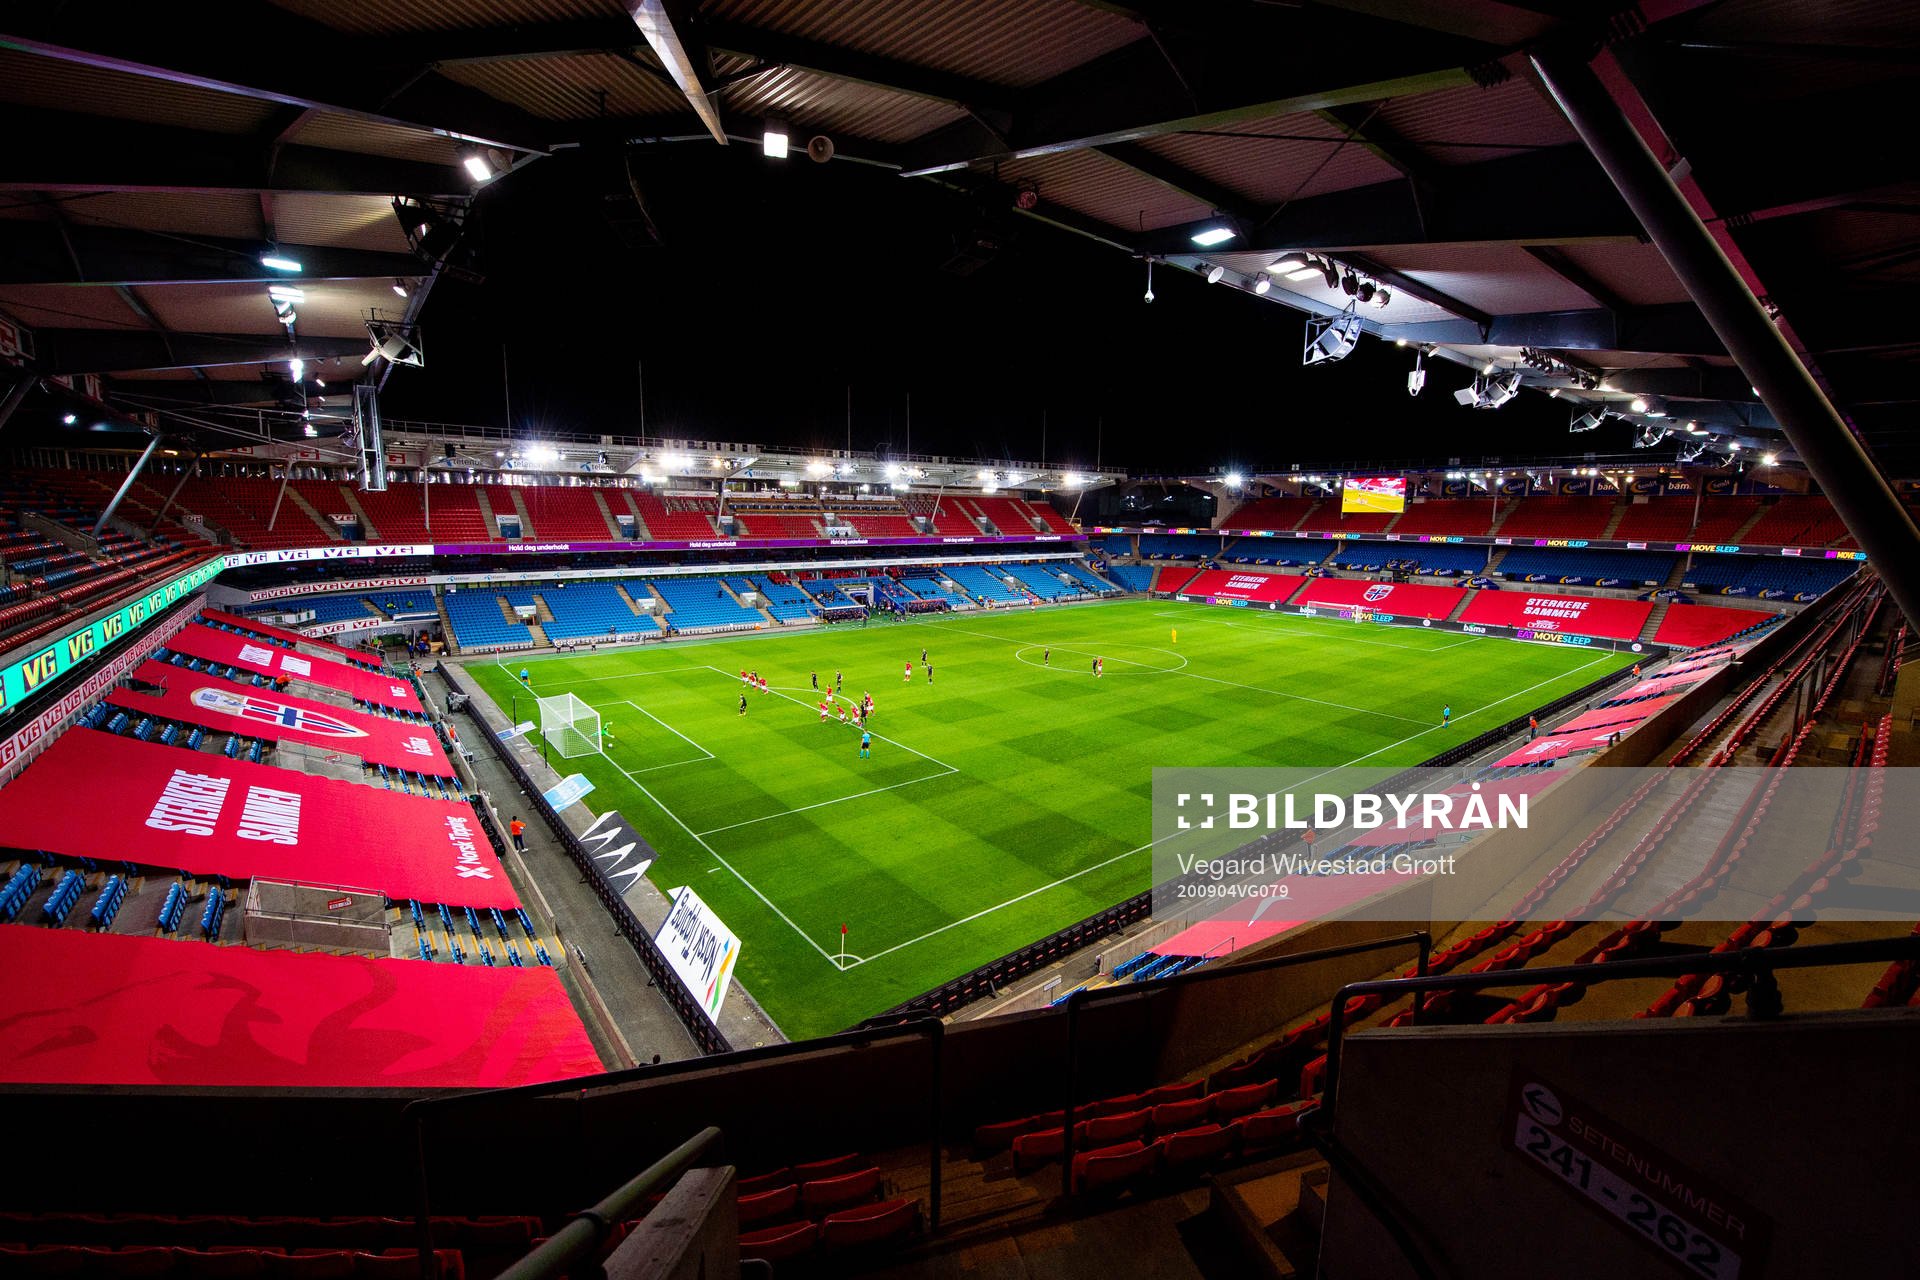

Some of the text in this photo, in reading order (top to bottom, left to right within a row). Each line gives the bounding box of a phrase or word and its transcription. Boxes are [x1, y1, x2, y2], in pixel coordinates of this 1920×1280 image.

[246, 553, 267, 564] VG
[278, 550, 308, 561] VG
[323, 548, 359, 557] VG
[376, 547, 413, 556] VG
[23, 649, 57, 690] VG
[68, 628, 94, 662] VG
[103, 613, 122, 641] VG
[129, 602, 144, 626] VG
[149, 593, 162, 613] VG
[1523, 606, 1581, 619] SAMMEN
[1526, 598, 1590, 610] STERKERE
[18, 722, 41, 752] VG
[43, 705, 62, 731] VG
[64, 690, 81, 715] VG
[82, 677, 97, 700] VG
[98, 666, 112, 687] VG
[112, 656, 124, 676] VG
[145, 769, 301, 845] STERKERE SAMMEN
[444, 816, 481, 865] Norsk Tipping
[671, 893, 721, 984] Norsk Tipping
[1526, 1125, 1593, 1190] 241
[1626, 1194, 1721, 1279] 262
[1568, 1116, 1745, 1241] SETENUMMER
